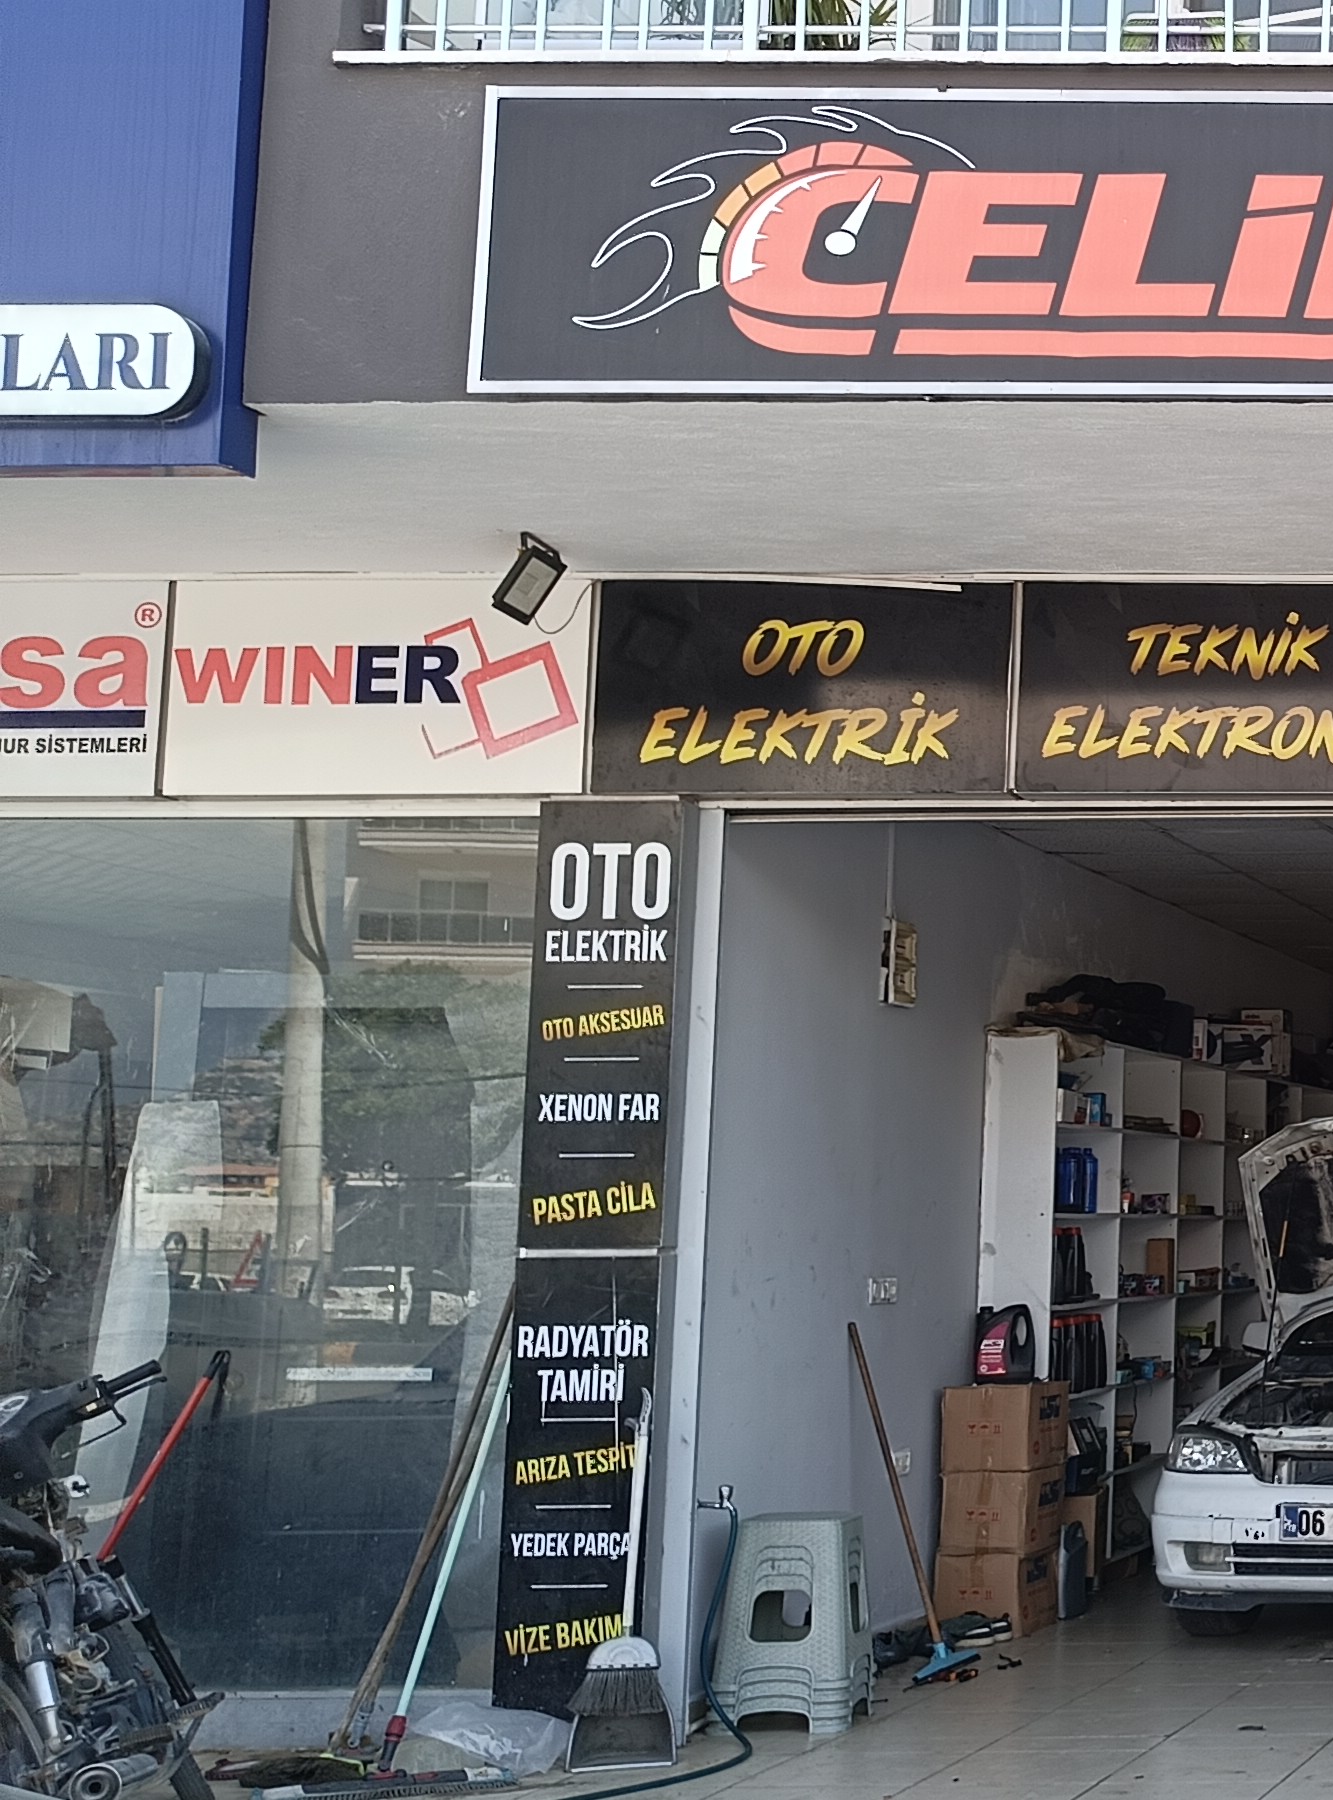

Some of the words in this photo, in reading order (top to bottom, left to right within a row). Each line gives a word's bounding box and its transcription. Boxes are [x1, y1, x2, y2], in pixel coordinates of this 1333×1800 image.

[0, 331, 173, 391] LARI
[741, 618, 866, 678] OTO
[1126, 611, 1330, 681] TEKNİK
[173, 644, 462, 706] WINER
[0, 737, 30, 754] UR
[34, 733, 147, 754] SİSTEMLERİ
[638, 691, 963, 766] ELEKTRİK
[549, 841, 672, 922] OTO
[544, 923, 669, 963] ELEKTRİK
[541, 1016, 574, 1042] OTO
[577, 1003, 665, 1037] AKSESUAR
[537, 1093, 615, 1123] XENON
[618, 1092, 661, 1122] FAR
[531, 1191, 602, 1226] PASTA
[606, 1180, 657, 1216] CİLA
[517, 1318, 650, 1359] RADYATÖR
[536, 1362, 625, 1403] TAMİRİ
[515, 1453, 572, 1486] ARIZA
[1299, 1509, 1326, 1537] 06
[510, 1532, 570, 1558] YEDEK
[504, 1622, 553, 1658] VİZE
